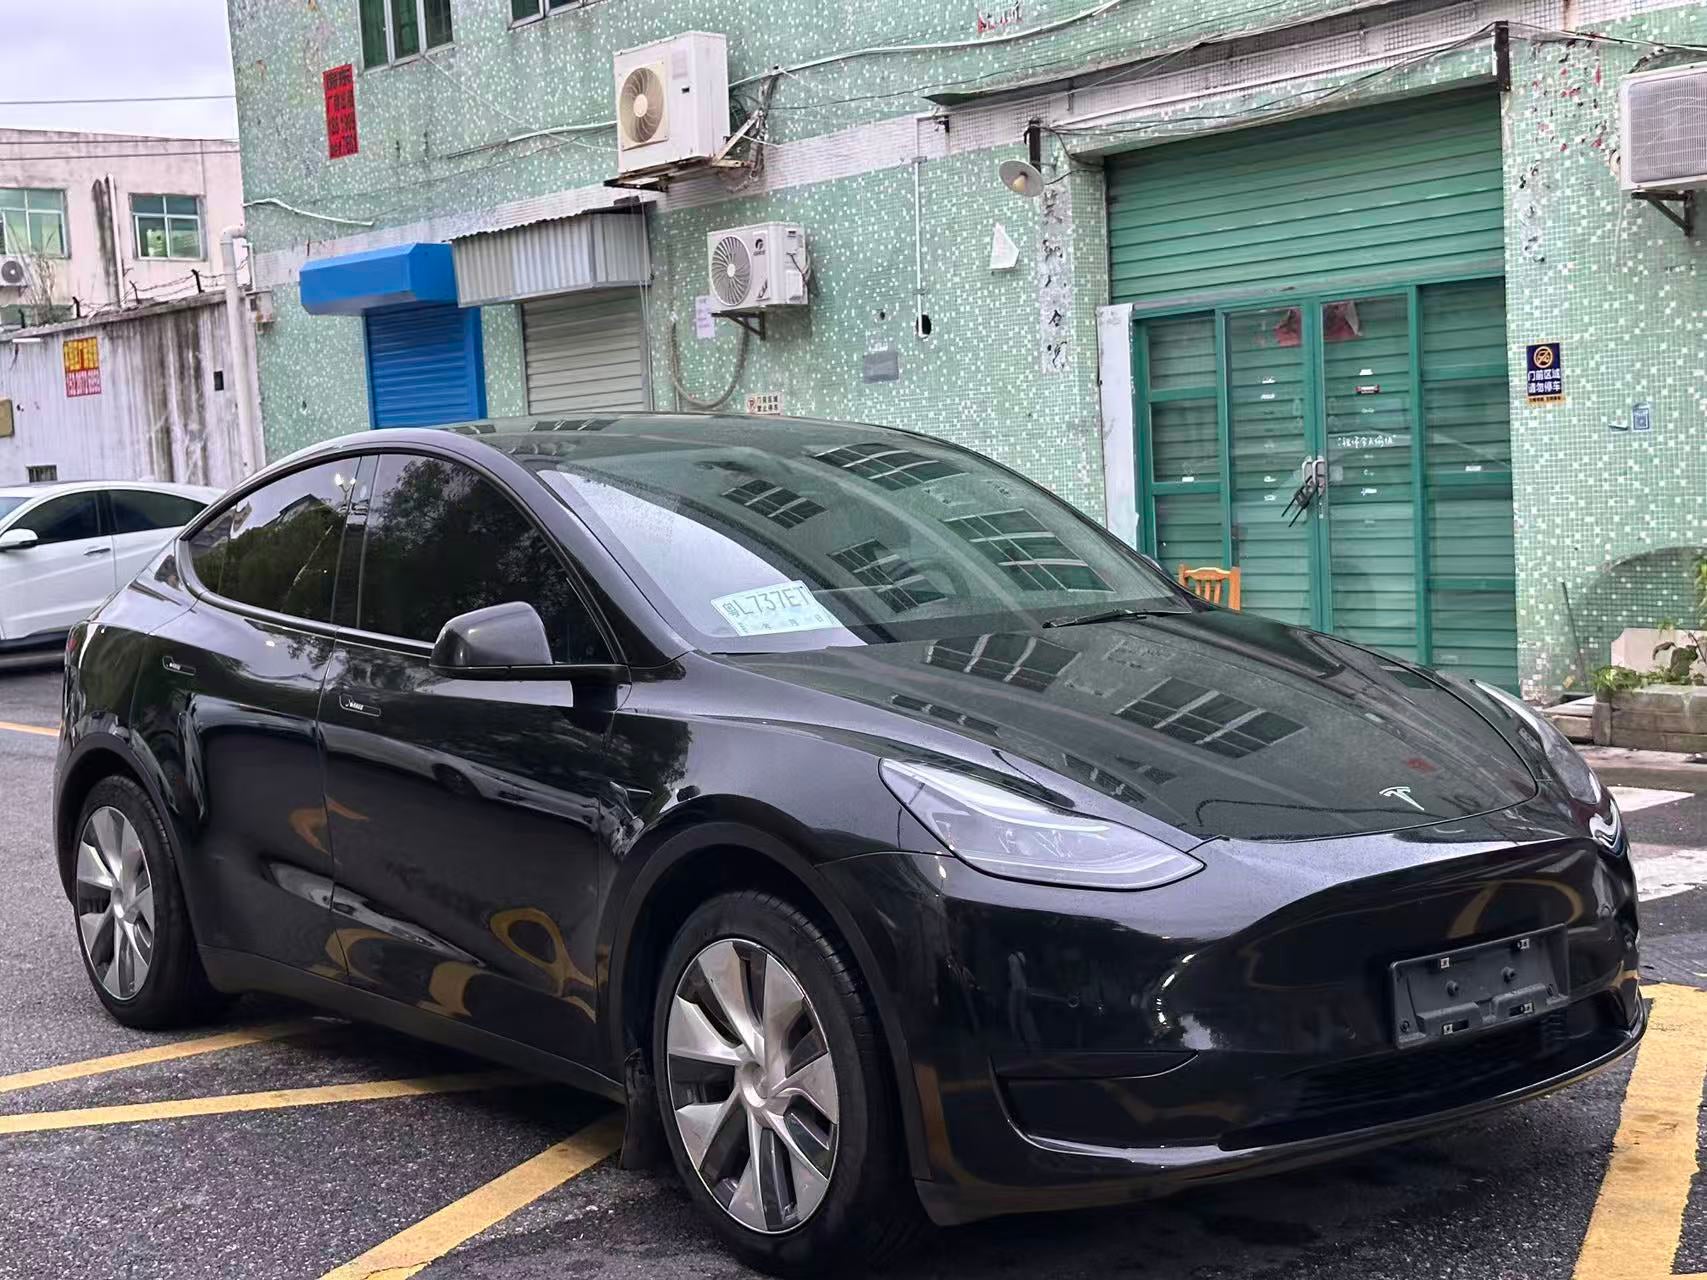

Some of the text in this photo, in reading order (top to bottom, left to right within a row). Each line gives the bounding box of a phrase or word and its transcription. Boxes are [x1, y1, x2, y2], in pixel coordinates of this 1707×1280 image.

[1527, 368, 1561, 381] 门前区域
[1528, 381, 1561, 393] 请勿停车
